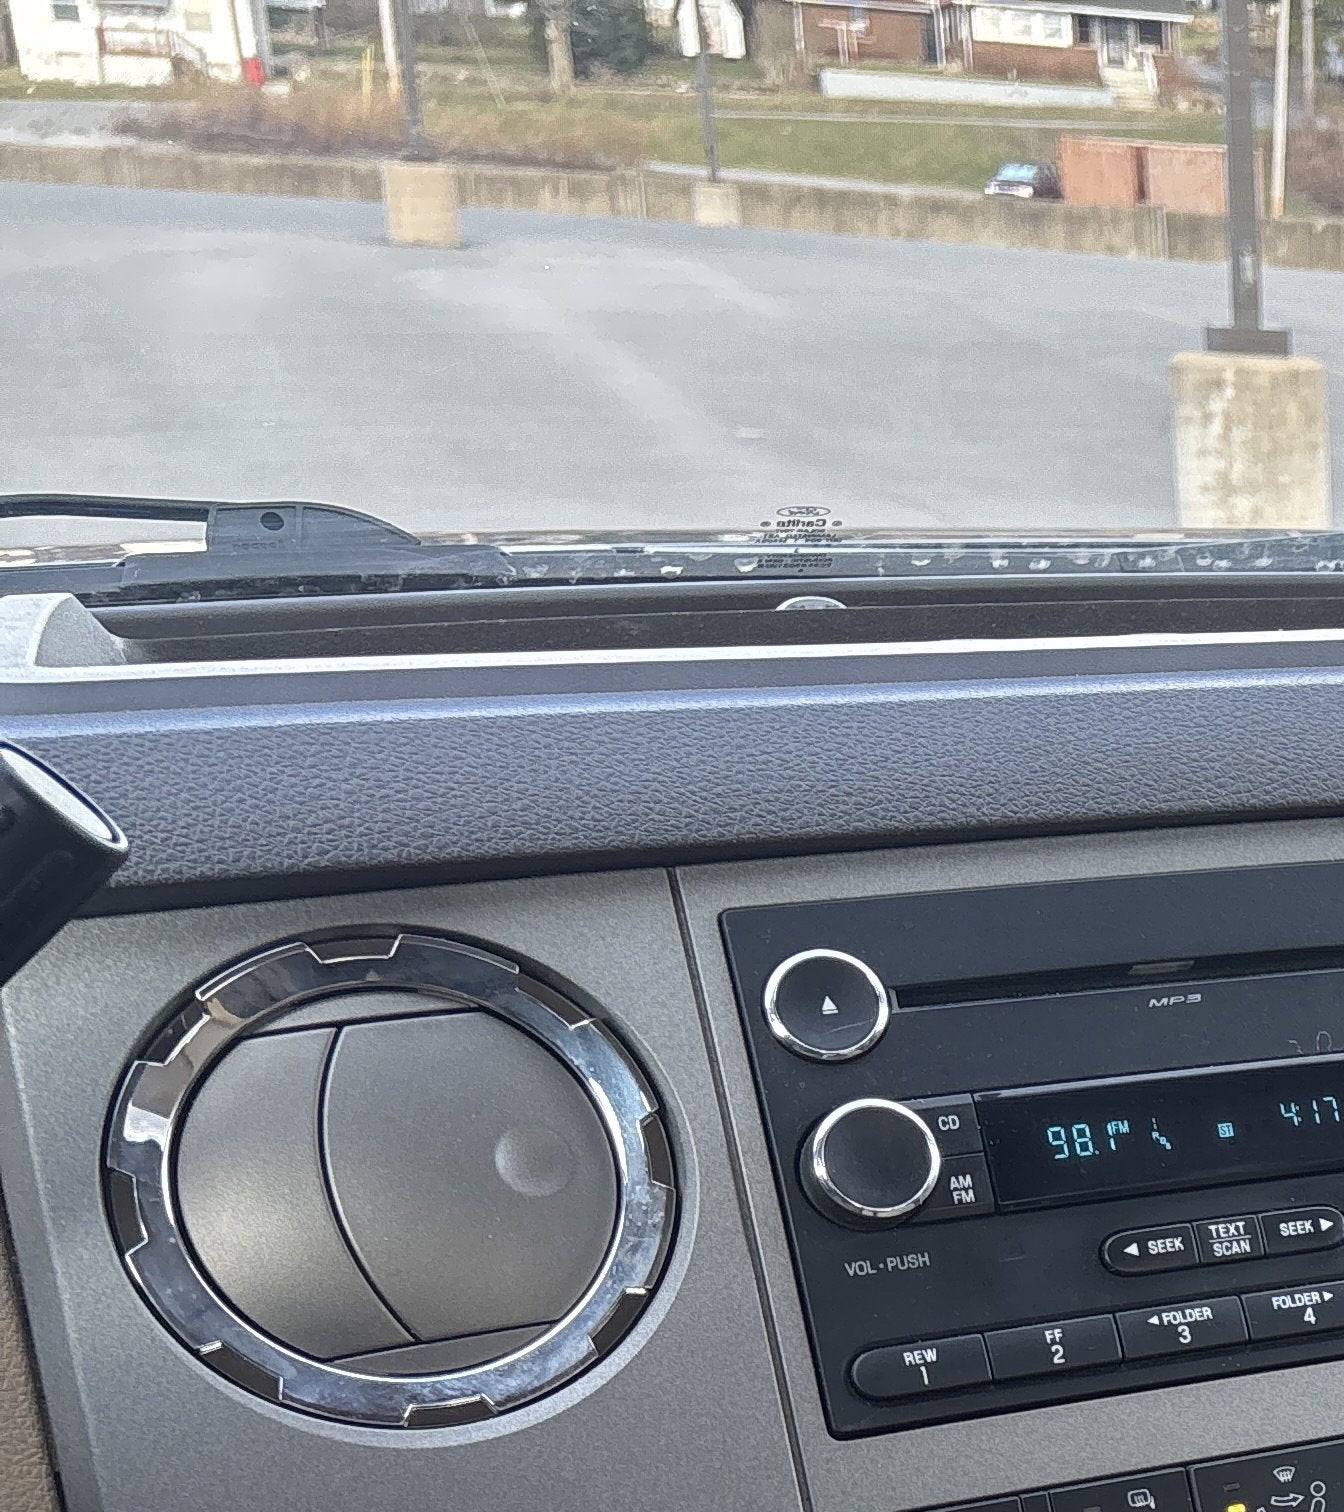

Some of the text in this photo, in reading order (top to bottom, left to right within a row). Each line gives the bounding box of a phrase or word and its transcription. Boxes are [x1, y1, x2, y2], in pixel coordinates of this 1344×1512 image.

[1148, 993, 1202, 1008] MP3
[1279, 1096, 1341, 1127] 4:17
[938, 1115, 960, 1131] CD
[950, 1174, 972, 1190] AM
[953, 1189, 975, 1204] FM
[1208, 1222, 1247, 1240] TEXT
[1279, 1220, 1315, 1237] SEEK
[1147, 1237, 1185, 1255] SEEK
[1213, 1239, 1251, 1257] SCAN
[1272, 1290, 1323, 1309] FOLDER
[1161, 1306, 1214, 1325] FOLDER
[1303, 1306, 1317, 1326] 4
[1045, 1328, 1063, 1345] FF
[1178, 1325, 1192, 1344] 3
[904, 1348, 938, 1367] REW
[1052, 1344, 1065, 1365] 2
[919, 1366, 928, 1386] 1
